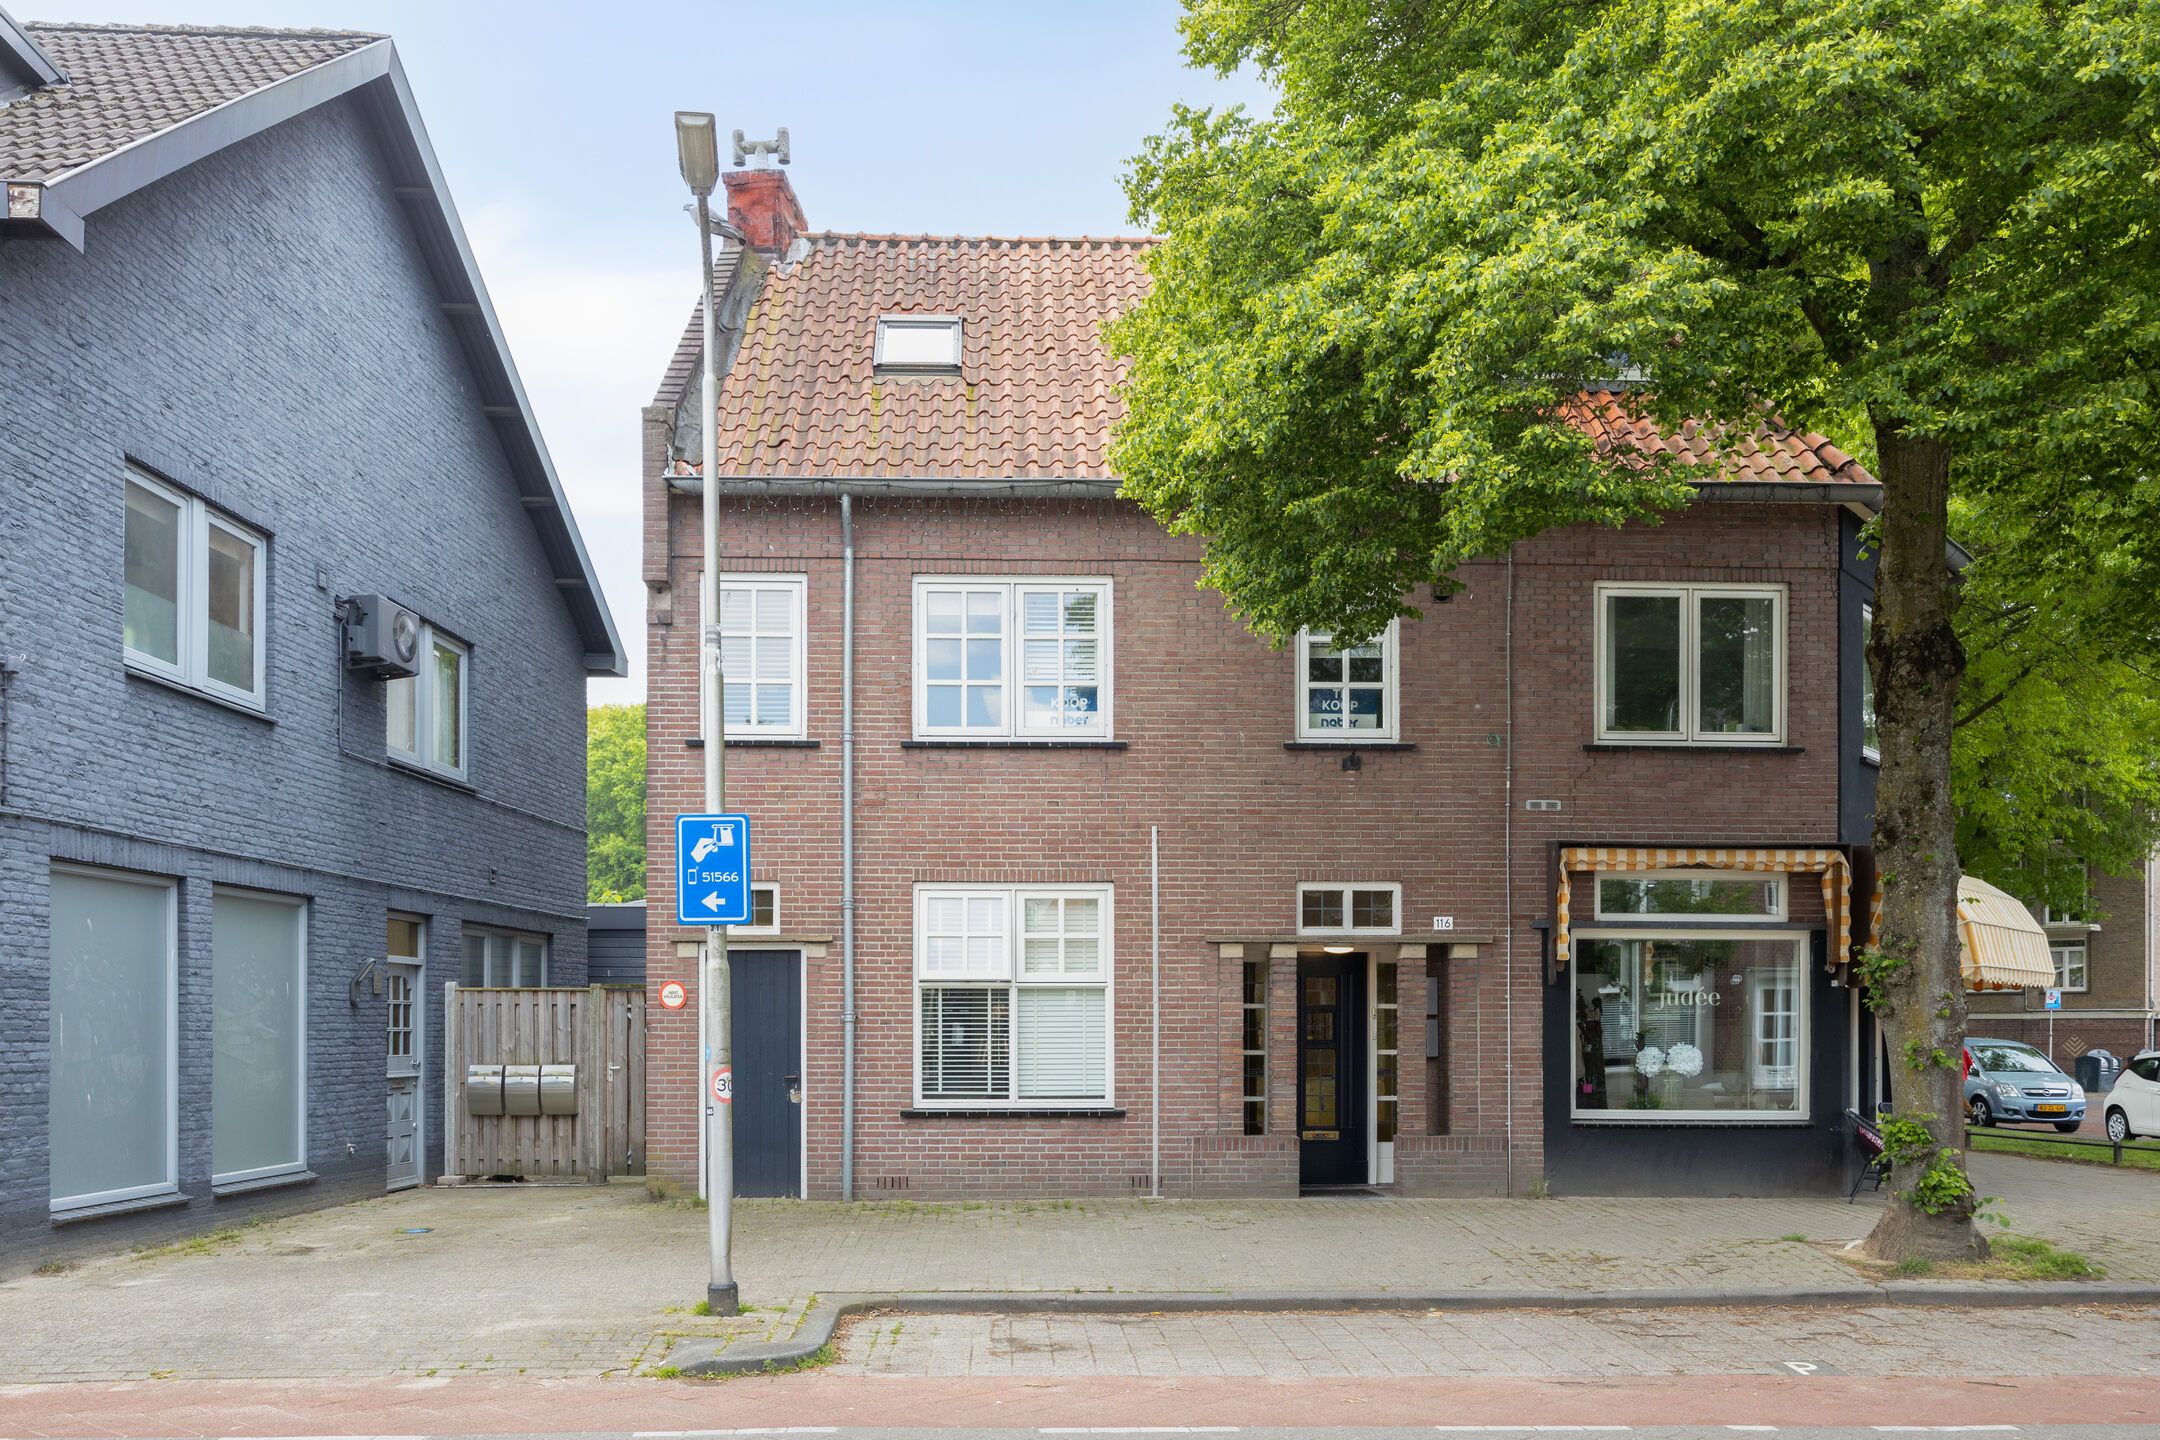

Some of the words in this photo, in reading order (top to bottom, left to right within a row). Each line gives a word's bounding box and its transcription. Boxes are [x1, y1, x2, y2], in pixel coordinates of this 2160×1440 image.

[1050, 714, 1088, 725] nber
[702, 871, 739, 882] 51566
[1436, 918, 1451, 928] 116
[1655, 986, 1721, 1010] judée
[1782, 1361, 1818, 1376] P
